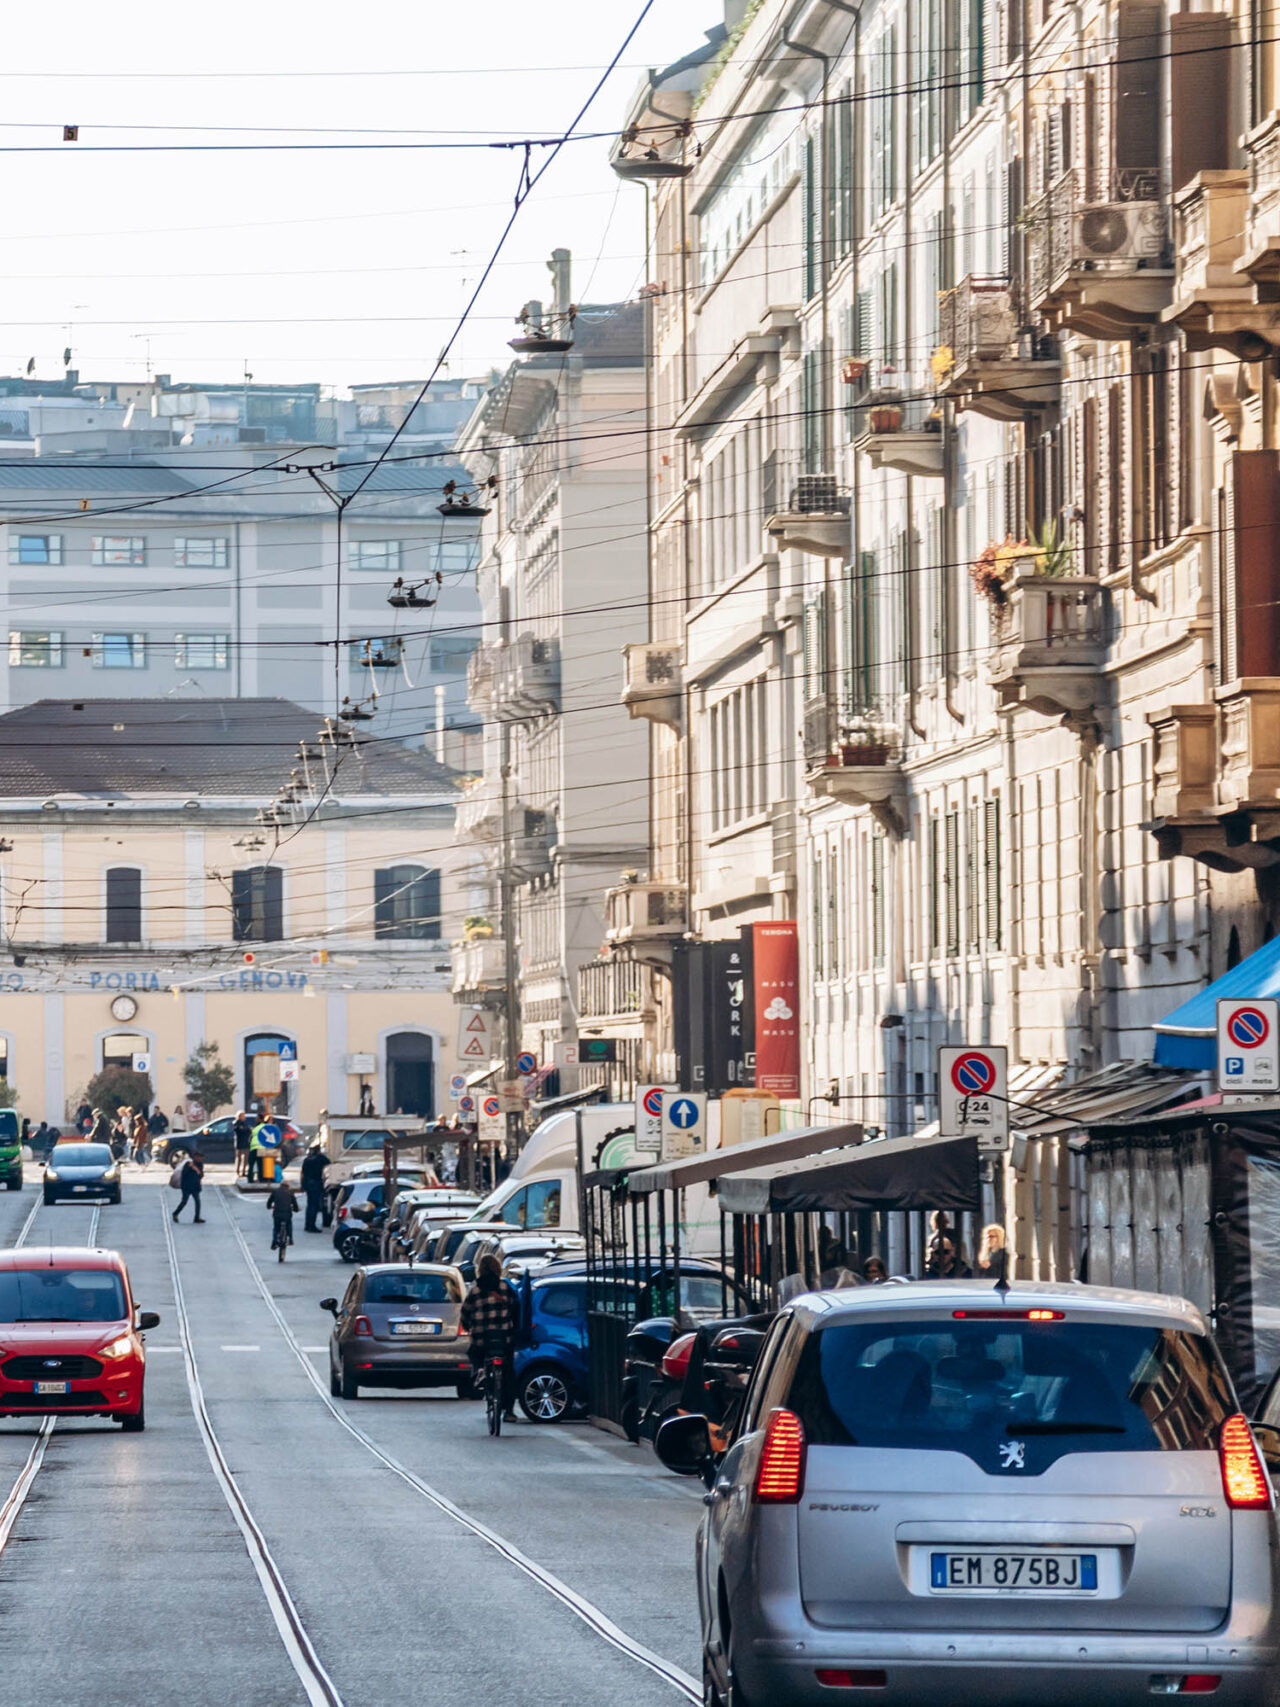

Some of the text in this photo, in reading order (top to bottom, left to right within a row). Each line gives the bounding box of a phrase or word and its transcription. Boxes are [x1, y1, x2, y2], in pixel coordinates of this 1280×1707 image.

[729, 953, 741, 965] &
[90, 972, 160, 989] PORTA
[219, 970, 308, 989] GENOVA
[1228, 1059, 1241, 1074] P
[959, 1101, 990, 1112] 0-24
[809, 1503, 880, 1512] PEUGEOT
[950, 1557, 982, 1585] EM
[994, 1557, 1078, 1586] 875BJ
